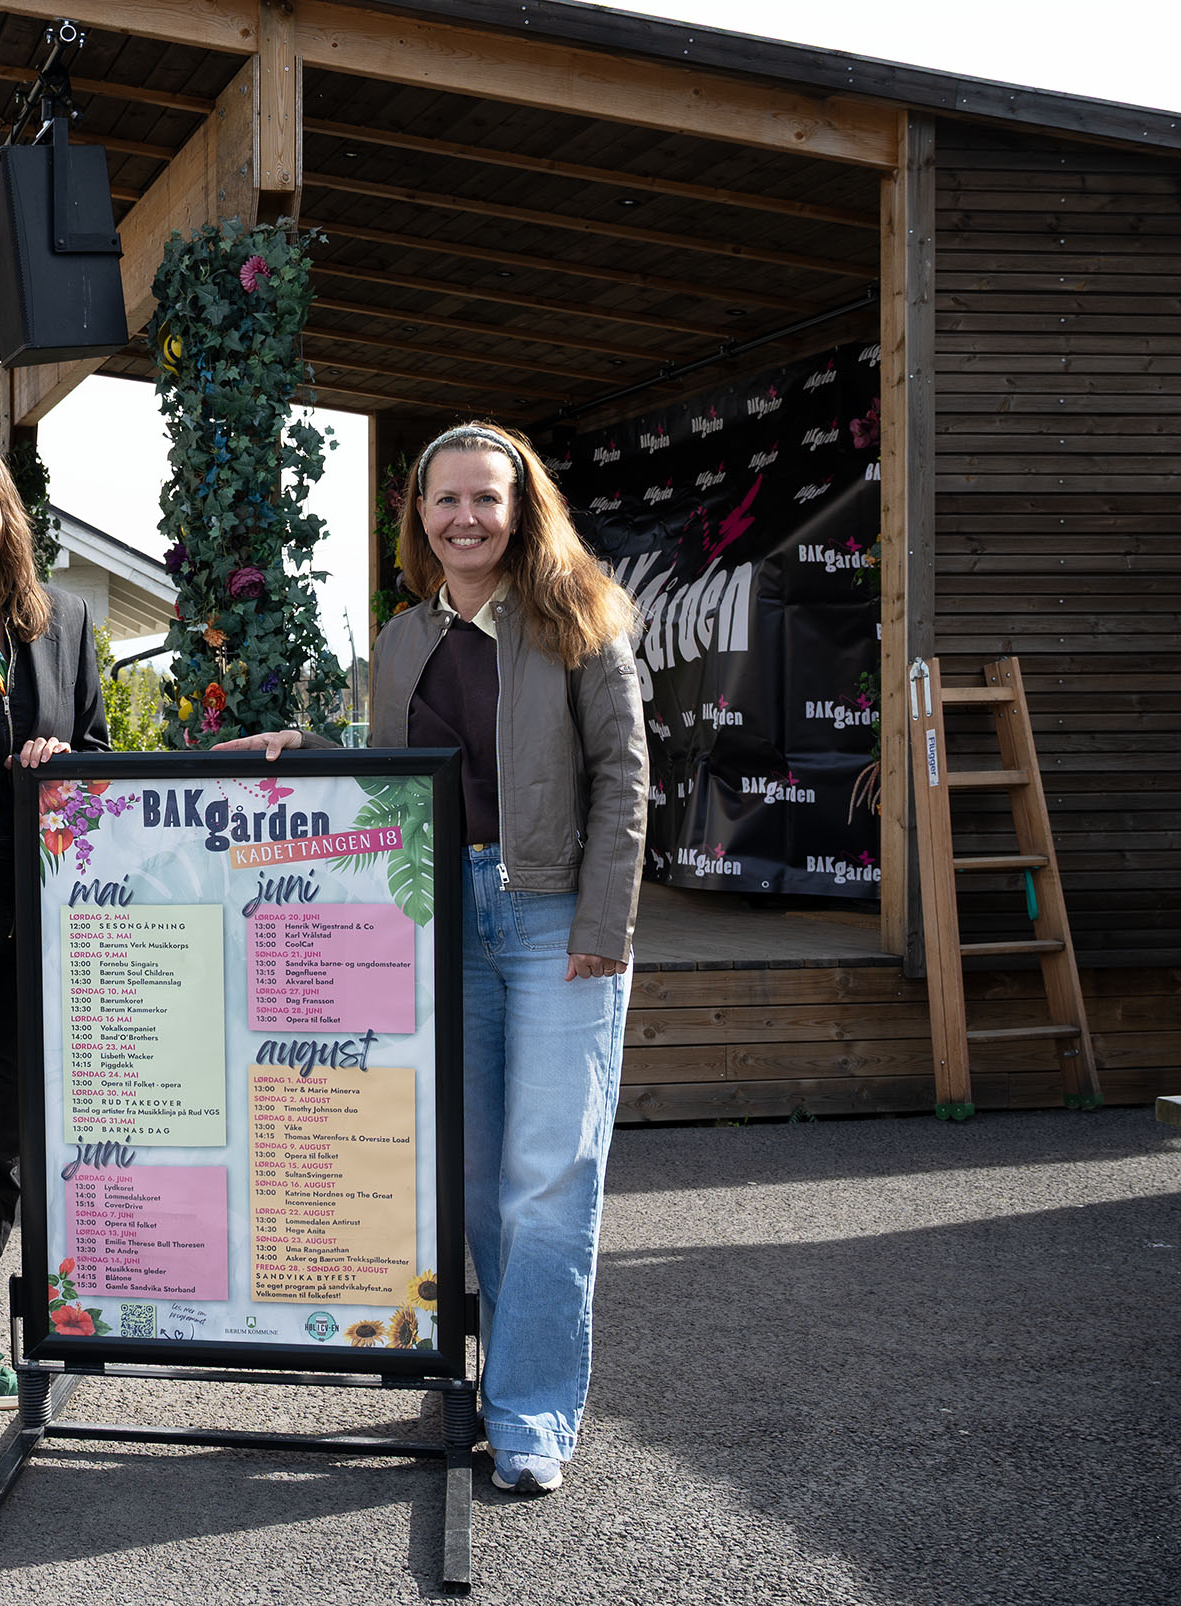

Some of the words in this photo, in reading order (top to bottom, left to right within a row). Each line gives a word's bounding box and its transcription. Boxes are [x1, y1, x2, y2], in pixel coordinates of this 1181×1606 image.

[741, 776, 816, 804] BAKgården
[142, 788, 330, 852] BAKgården
[235, 832, 371, 865] KADETTANGEN
[378, 829, 398, 848] 18
[806, 855, 882, 884] BAKgårde
[68, 873, 135, 908] mai
[241, 868, 321, 918] juni
[255, 1028, 379, 1078] august
[72, 1070, 106, 1078] SØNDAG
[72, 1116, 107, 1124] SØNDAG
[101, 1126, 144, 1134] BARNAS
[60, 1134, 136, 1182] juni
[248, 1328, 279, 1336] KOMMUNE
